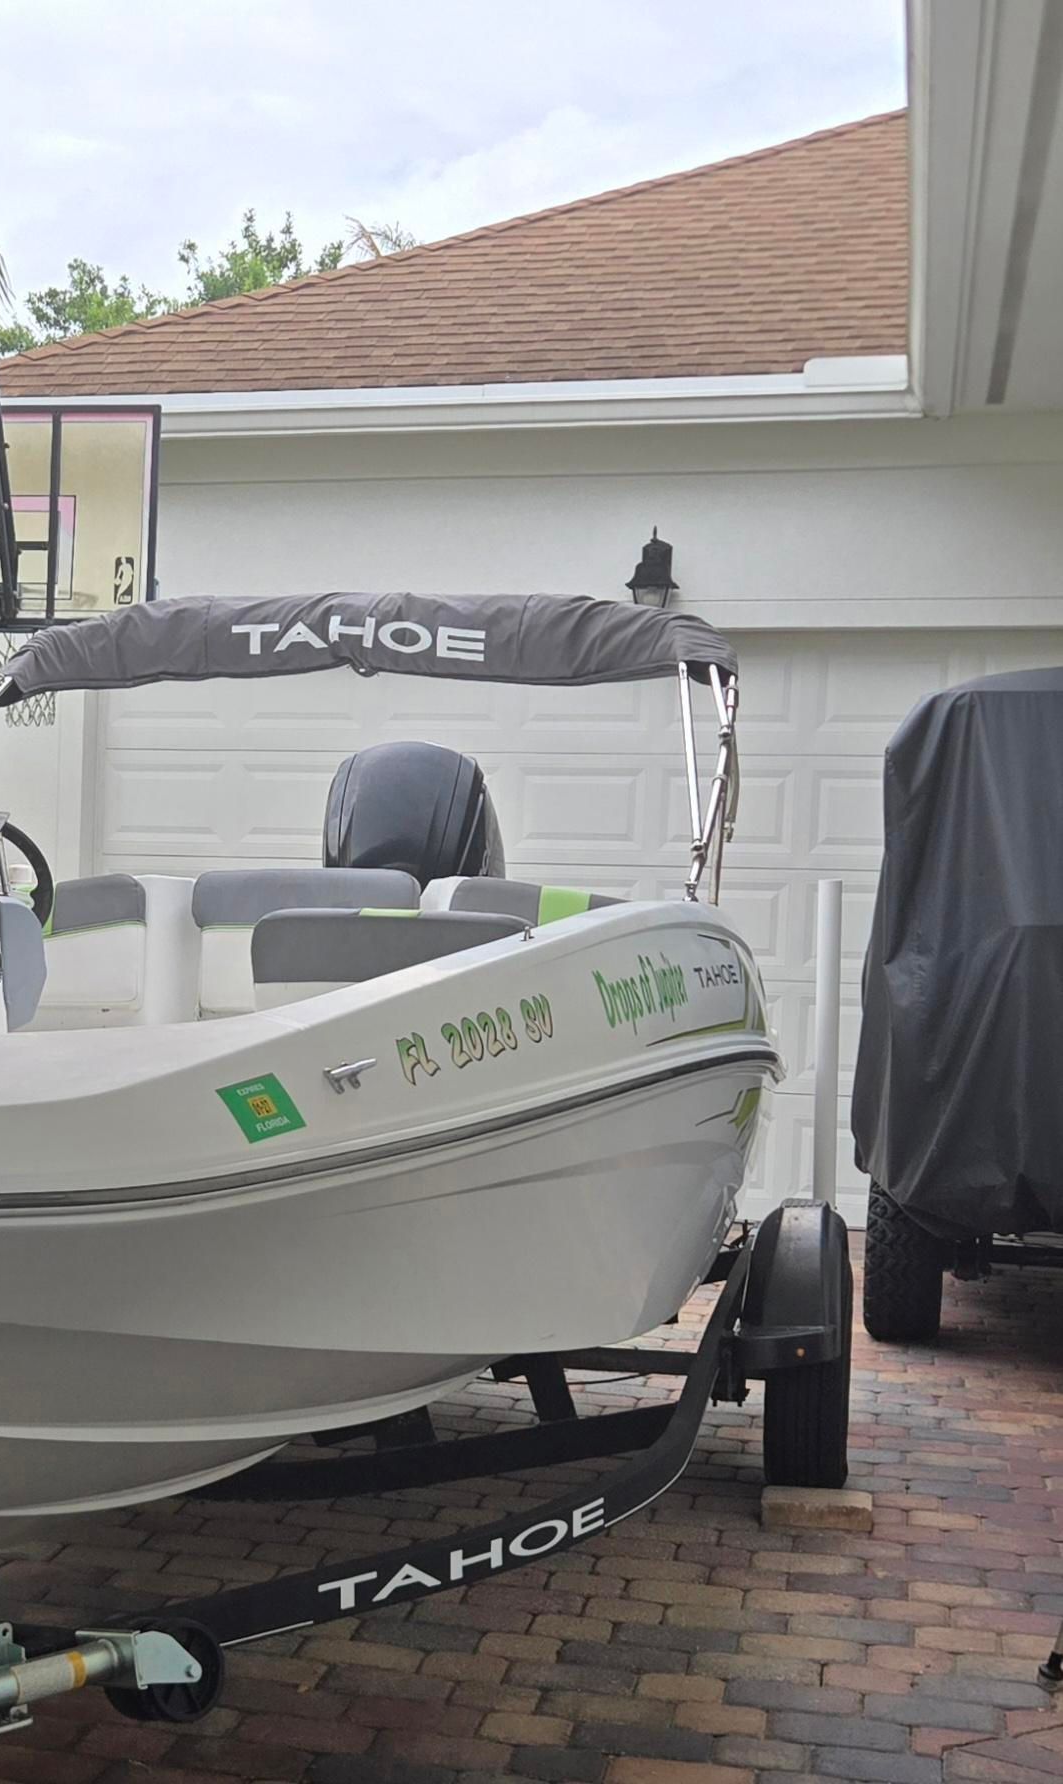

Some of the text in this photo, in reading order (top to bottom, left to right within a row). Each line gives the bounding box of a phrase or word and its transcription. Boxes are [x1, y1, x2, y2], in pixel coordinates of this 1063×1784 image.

[231, 615, 486, 662] TAHOE
[592, 970, 644, 1036] Drops
[637, 954, 657, 1015] of
[693, 964, 739, 988] TAHOE
[395, 1031, 441, 1086] FL
[440, 1006, 518, 1069] 2028
[256, 1116, 291, 1132] FLORIDA
[317, 1496, 605, 1611] TAHOE
